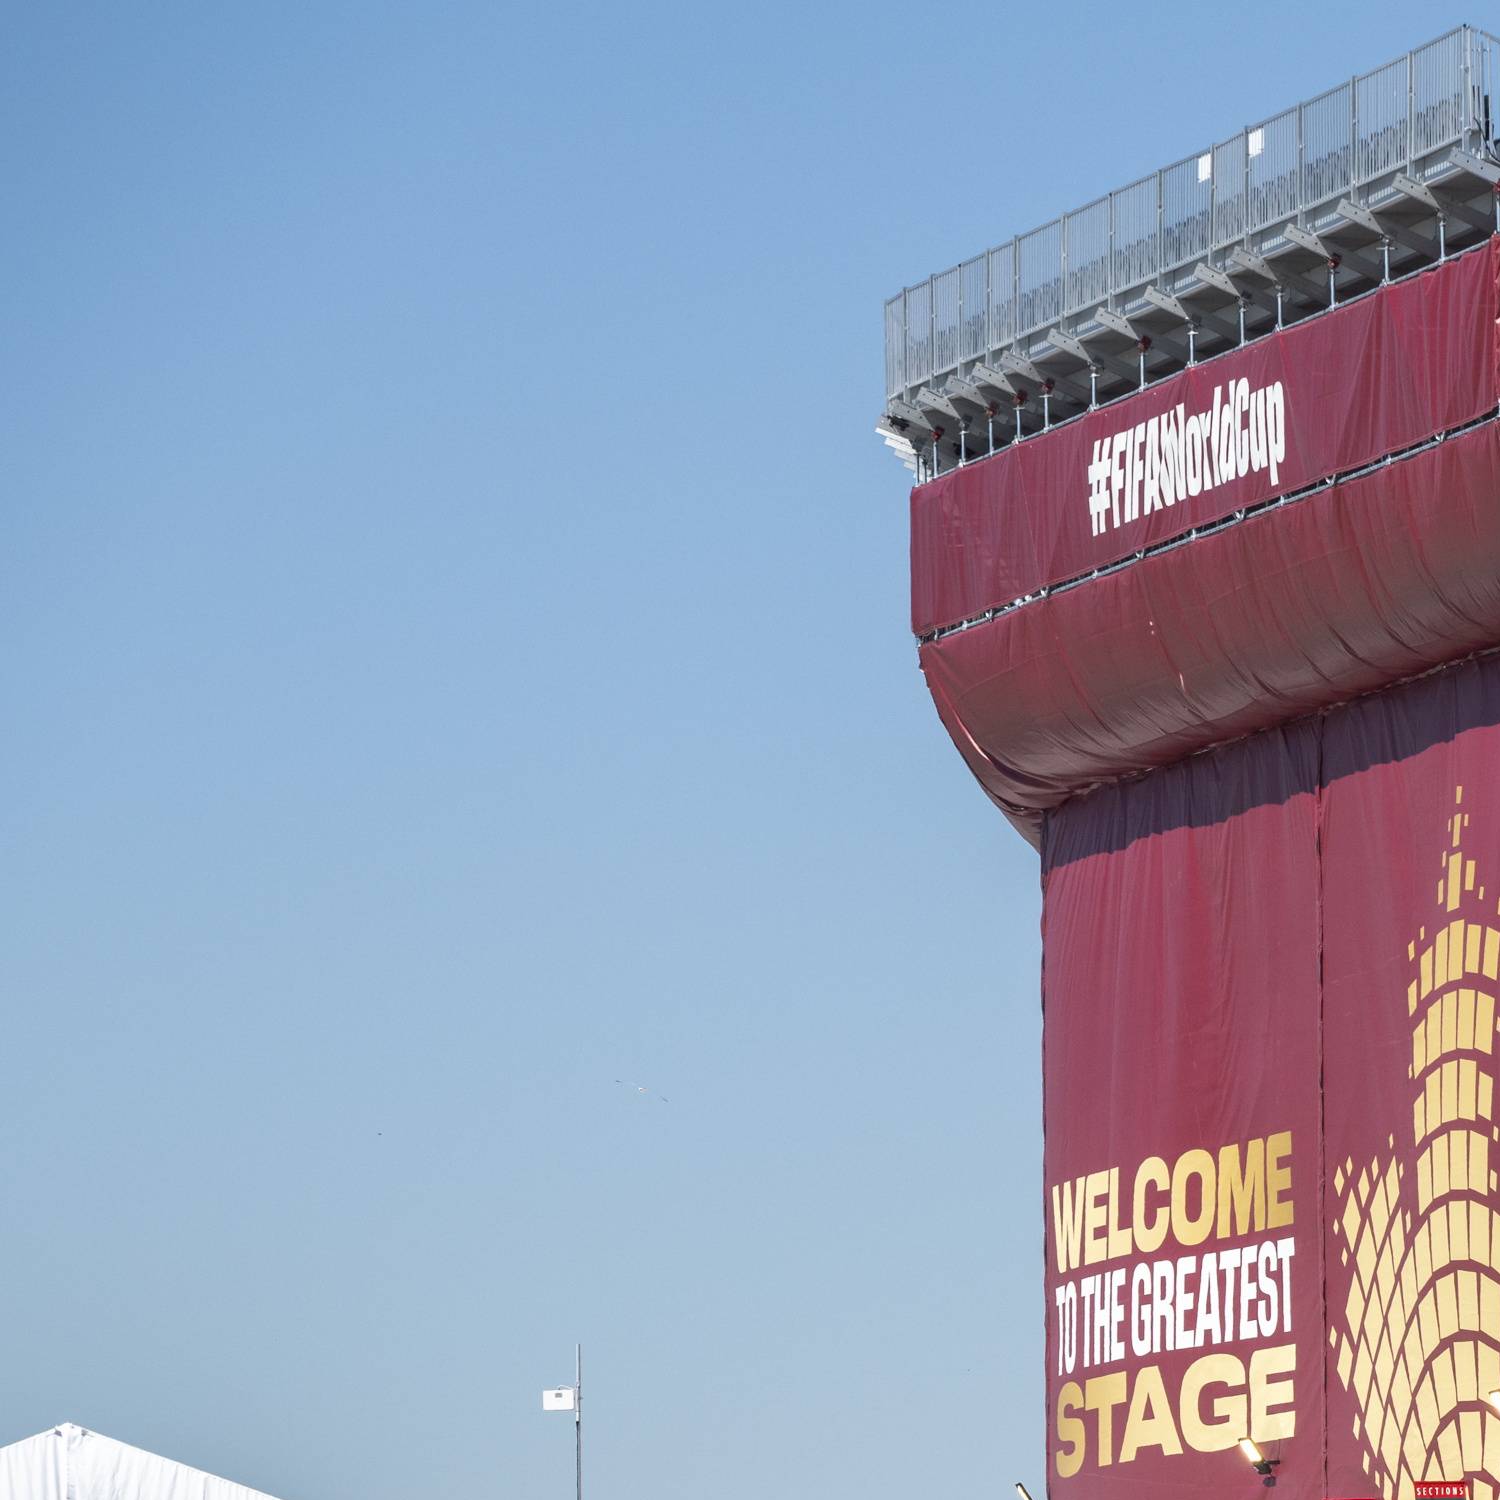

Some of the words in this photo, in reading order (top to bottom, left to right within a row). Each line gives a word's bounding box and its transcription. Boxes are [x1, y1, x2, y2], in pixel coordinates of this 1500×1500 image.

[1088, 377, 1286, 537] #FIFAWorldCup
[1052, 1131, 1294, 1274] WELCOME
[1055, 1281, 1078, 1377] TO
[1081, 1267, 1126, 1368] THE
[1131, 1236, 1295, 1357] GREATEST
[1056, 1343, 1297, 1479] STAGE
[1417, 1486, 1464, 1496] SECTIONS
